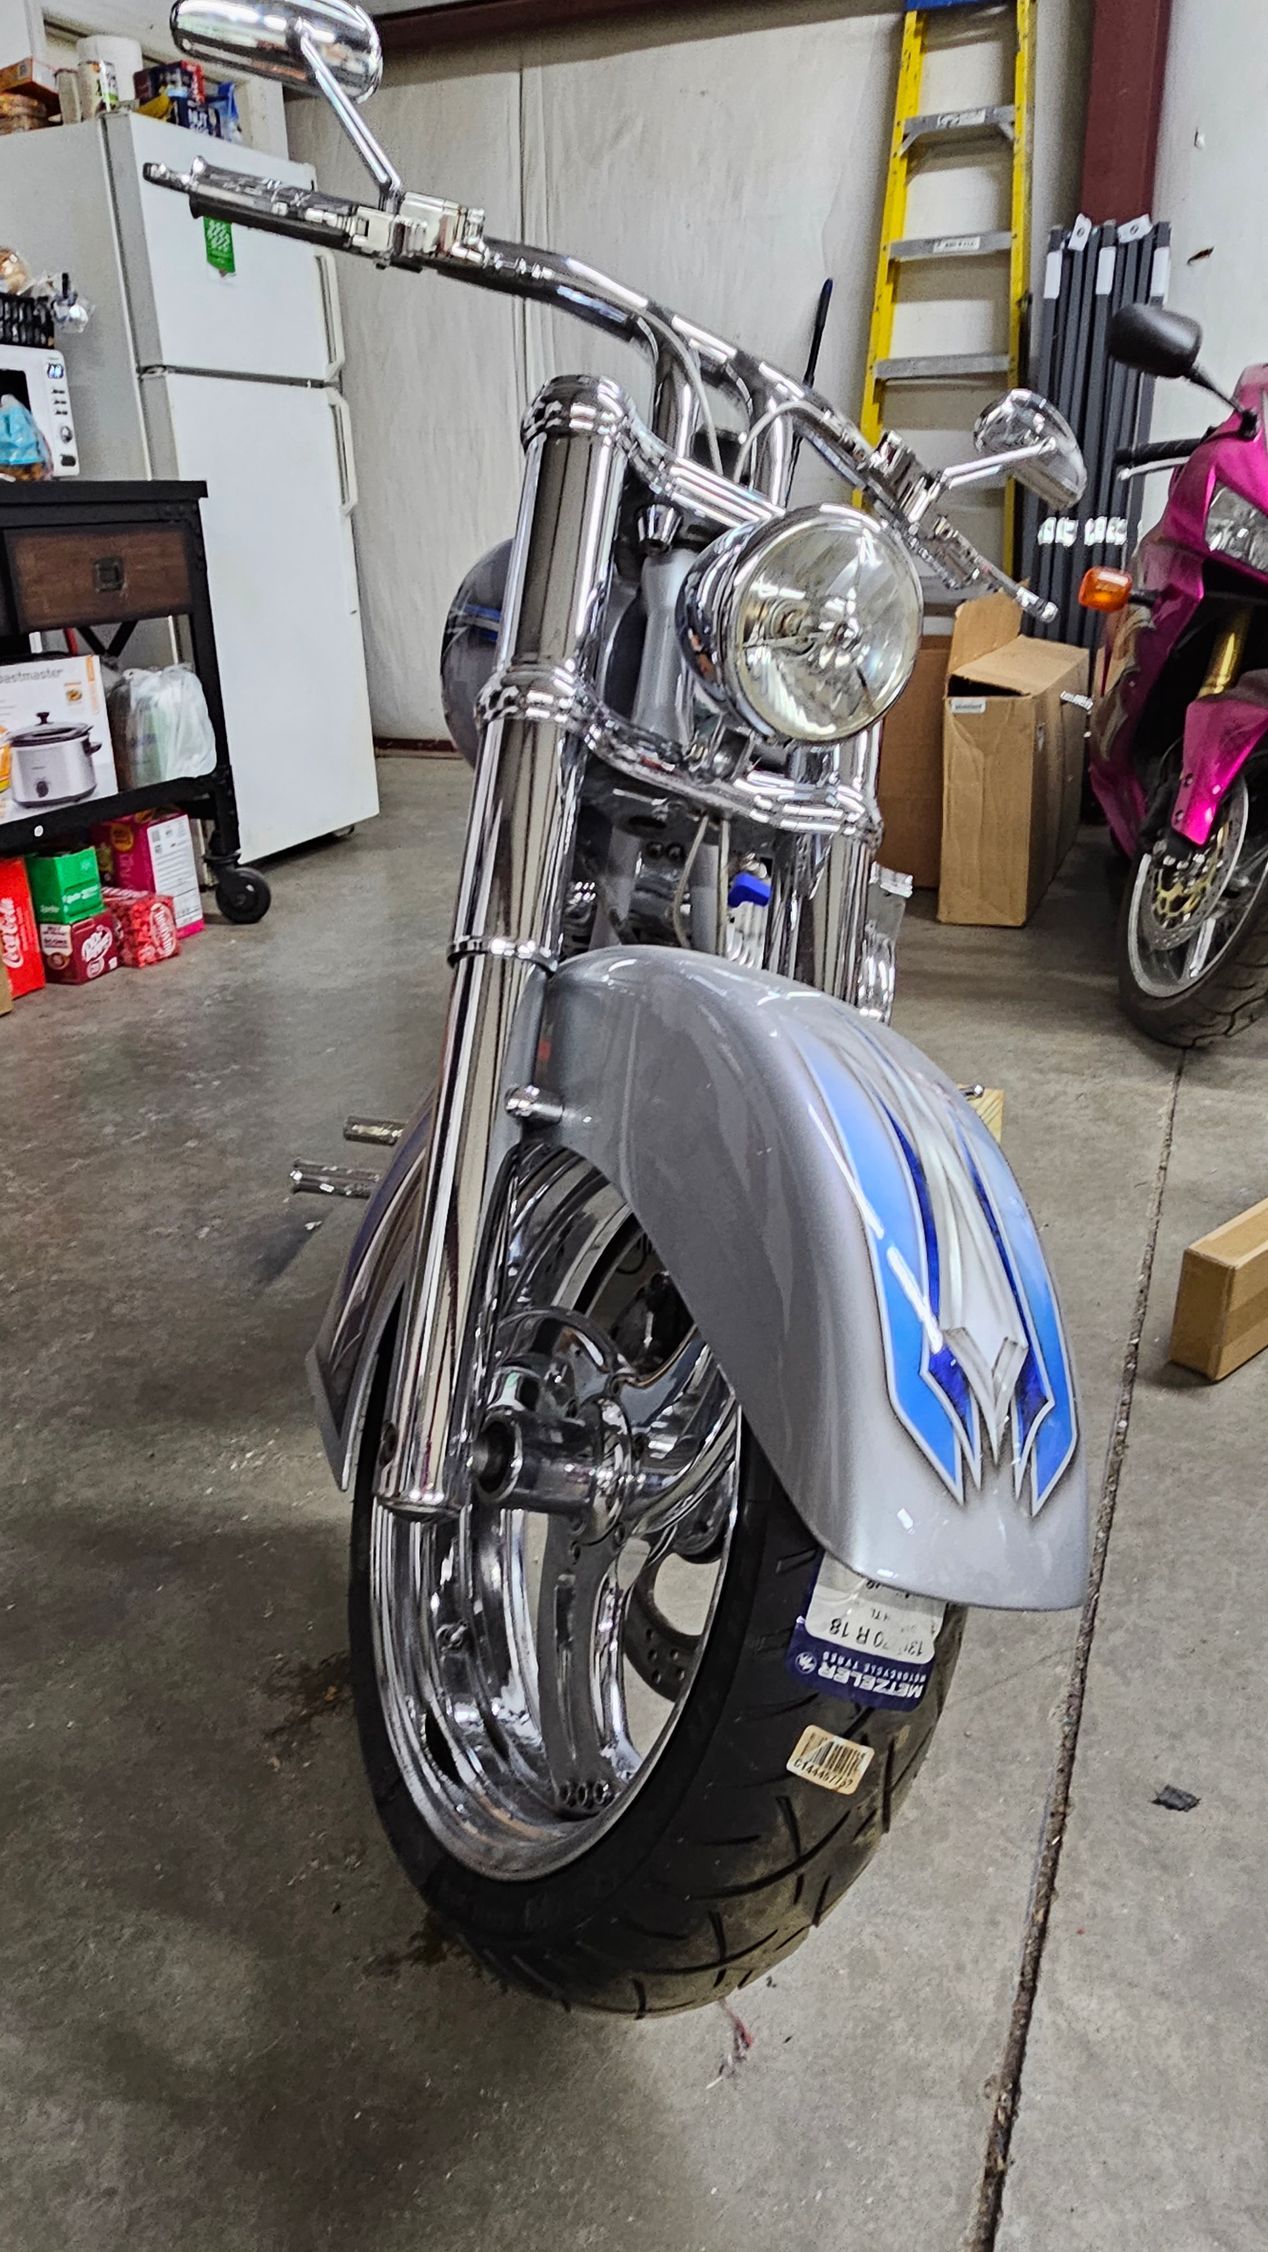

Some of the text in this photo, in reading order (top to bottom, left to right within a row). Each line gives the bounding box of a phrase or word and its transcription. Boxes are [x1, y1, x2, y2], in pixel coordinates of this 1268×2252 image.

[829, 1617, 850, 1639] 18
[856, 1625, 871, 1646] R
[817, 1661, 925, 1699] METZELER
[822, 1650, 927, 1684] MOTORCYCLE TYRES
